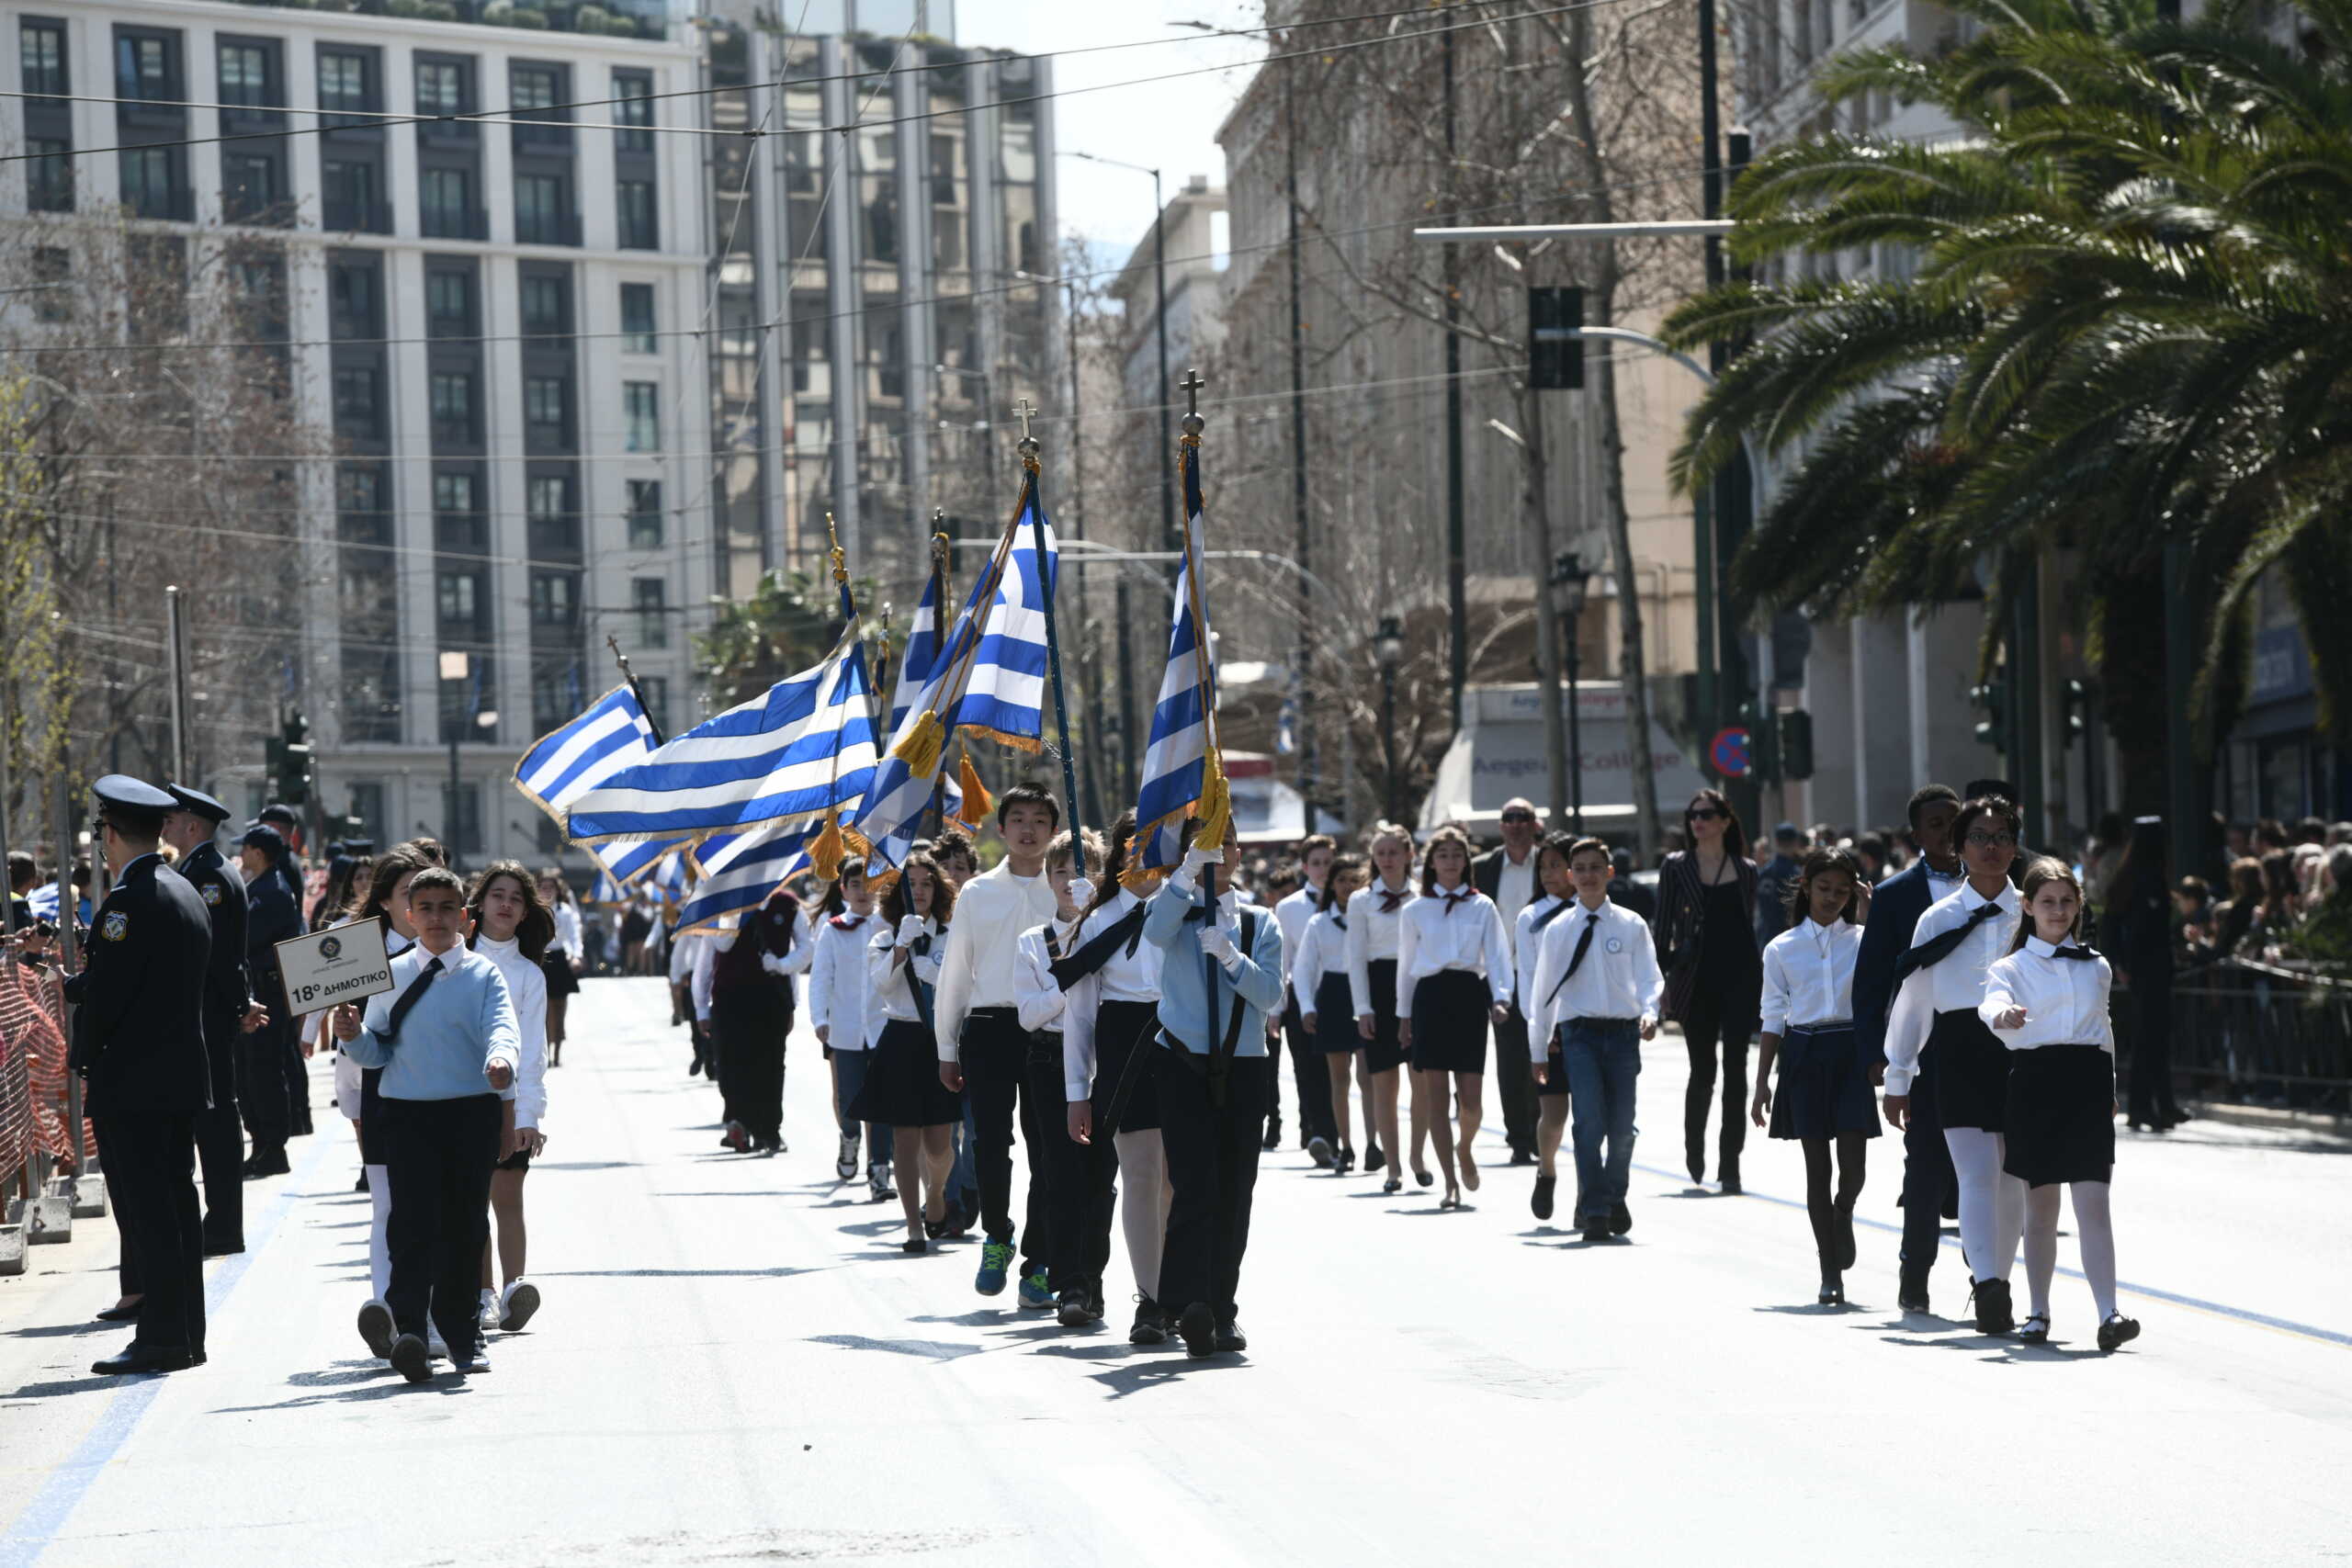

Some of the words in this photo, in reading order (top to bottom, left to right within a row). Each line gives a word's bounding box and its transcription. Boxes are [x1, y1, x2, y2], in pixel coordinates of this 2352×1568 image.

[1473, 756, 1569, 777] Aege
[1579, 751, 1680, 773] Collge
[324, 970, 388, 997] ΔΗΜΟΤΙΚΟ
